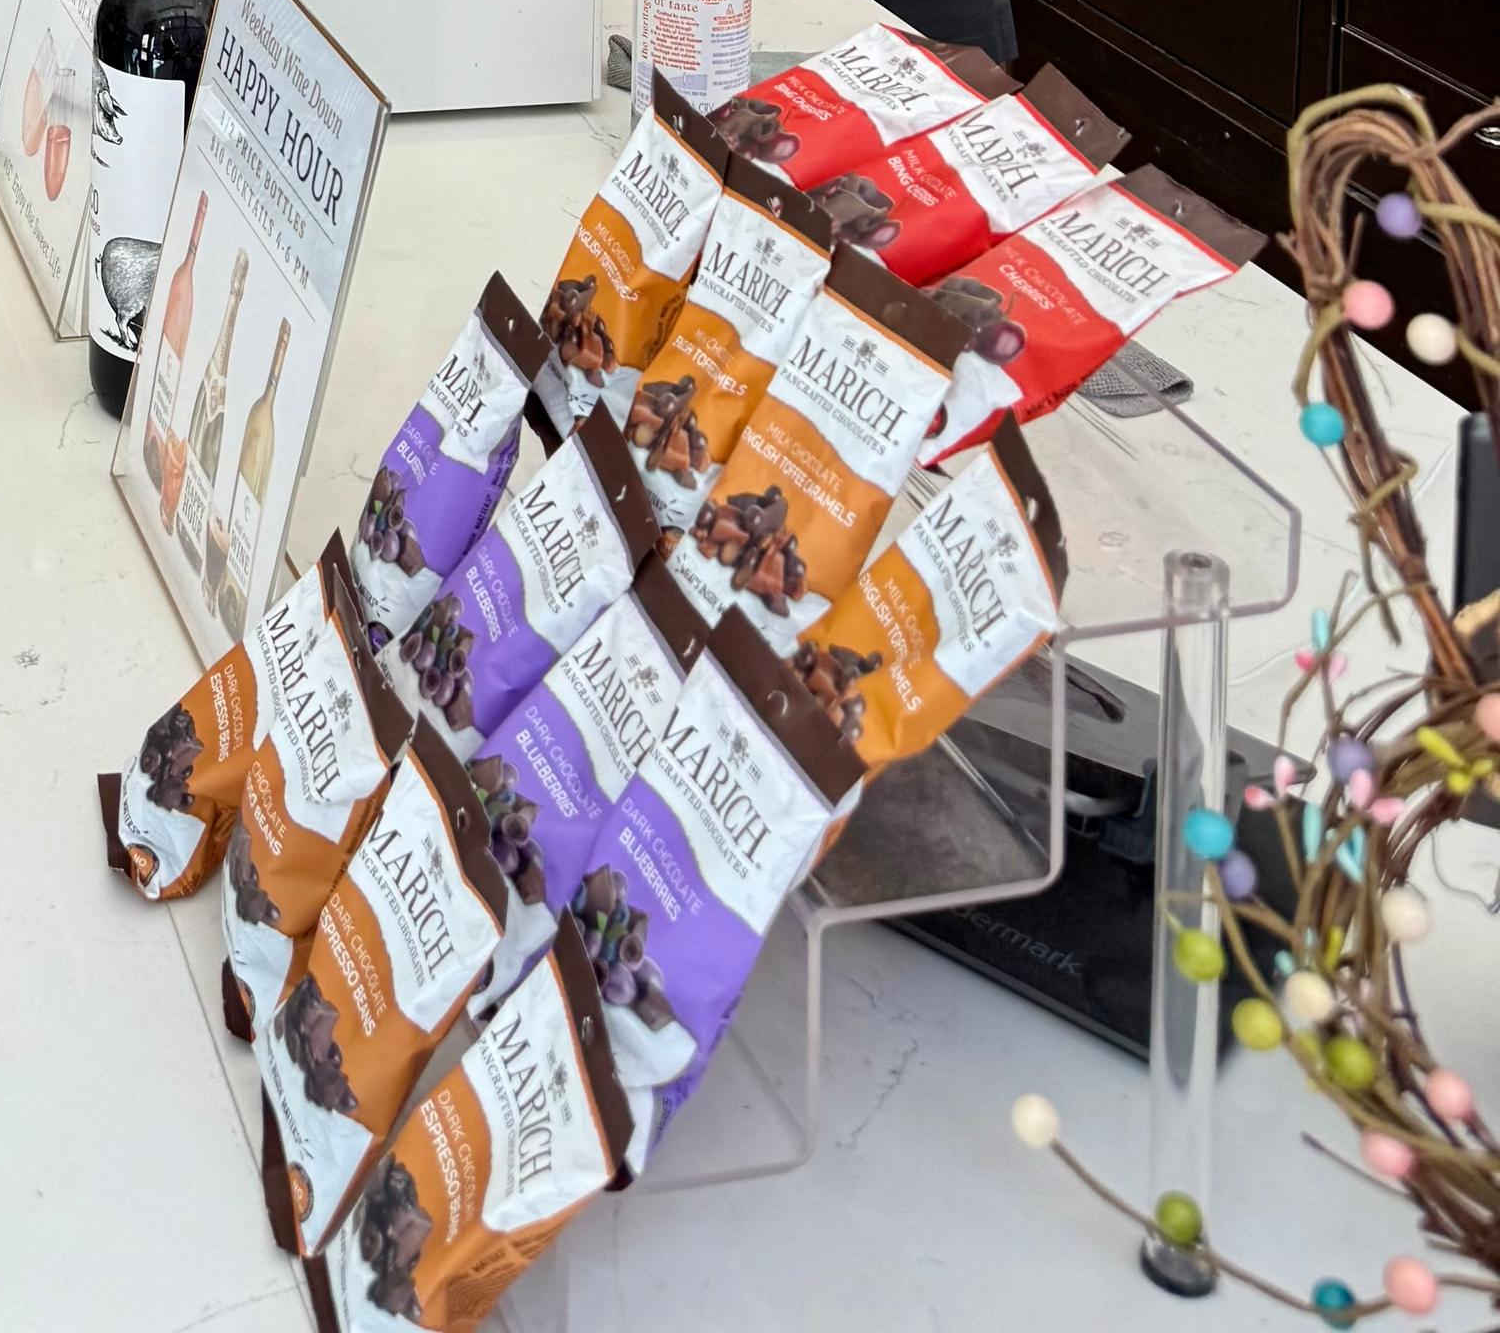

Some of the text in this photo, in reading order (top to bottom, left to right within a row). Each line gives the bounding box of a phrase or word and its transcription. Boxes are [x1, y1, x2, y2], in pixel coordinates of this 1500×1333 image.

[669, 0, 699, 13] taste
[216, 25, 345, 227] HAPPY HOUR
[283, 45, 310, 98] Wine
[307, 79, 345, 141] Down
[11, 173, 26, 216] Enjoy
[210, 134, 225, 165] $10
[225, 157, 275, 238] COCKTAILS
[292, 255, 310, 290] PM
[235, 136, 263, 180] PRICE
[263, 170, 307, 240] BOTTLES
[619, 150, 690, 239] MARICH
[887, 155, 911, 191] BING
[578, 225, 603, 259] NGLISH
[702, 240, 793, 321] MARICH
[1049, 210, 1171, 298] MARICH
[402, 419, 425, 451] DARK
[780, 368, 888, 456] PANCRAFTED CHOCOLATES
[788, 335, 908, 442] MARICH
[741, 425, 782, 468] ENGLISH
[519, 480, 587, 605] MARICH
[924, 493, 1008, 643] MARICH
[858, 571, 895, 630] ENGLISH
[884, 577, 909, 616] MILK
[223, 662, 238, 694] DARK
[265, 603, 310, 694] MARI
[210, 672, 230, 732] ESPRESSO
[291, 689, 341, 799] ARICH
[560, 660, 633, 782] PANCRAFTED CHOCOLATE
[572, 636, 657, 769] MARICH
[251, 760, 287, 840] CHOCOLATE
[515, 728, 580, 818] BLUEBERRIES
[524, 704, 604, 820] DARK CHOCOLATE
[649, 739, 750, 880] ANCRAFTED CHOCOLATES
[660, 705, 772, 865] MARICH
[132, 852, 148, 868] NO
[252, 803, 284, 857] BEANS
[618, 826, 682, 922] BLUEBERRIES
[621, 796, 705, 916] DARK CHOCOLATE
[358, 848, 426, 989] NCRAFTED CHOCOLATES
[367, 810, 456, 975] MARICH
[319, 906, 377, 1038] ESPRESSO BEANS
[330, 892, 388, 1017] DARK CHOCOLATE
[420, 1099, 461, 1197] ESPRESSO
[437, 1088, 462, 1143] DARK
[490, 1012, 553, 1190] MARICH
